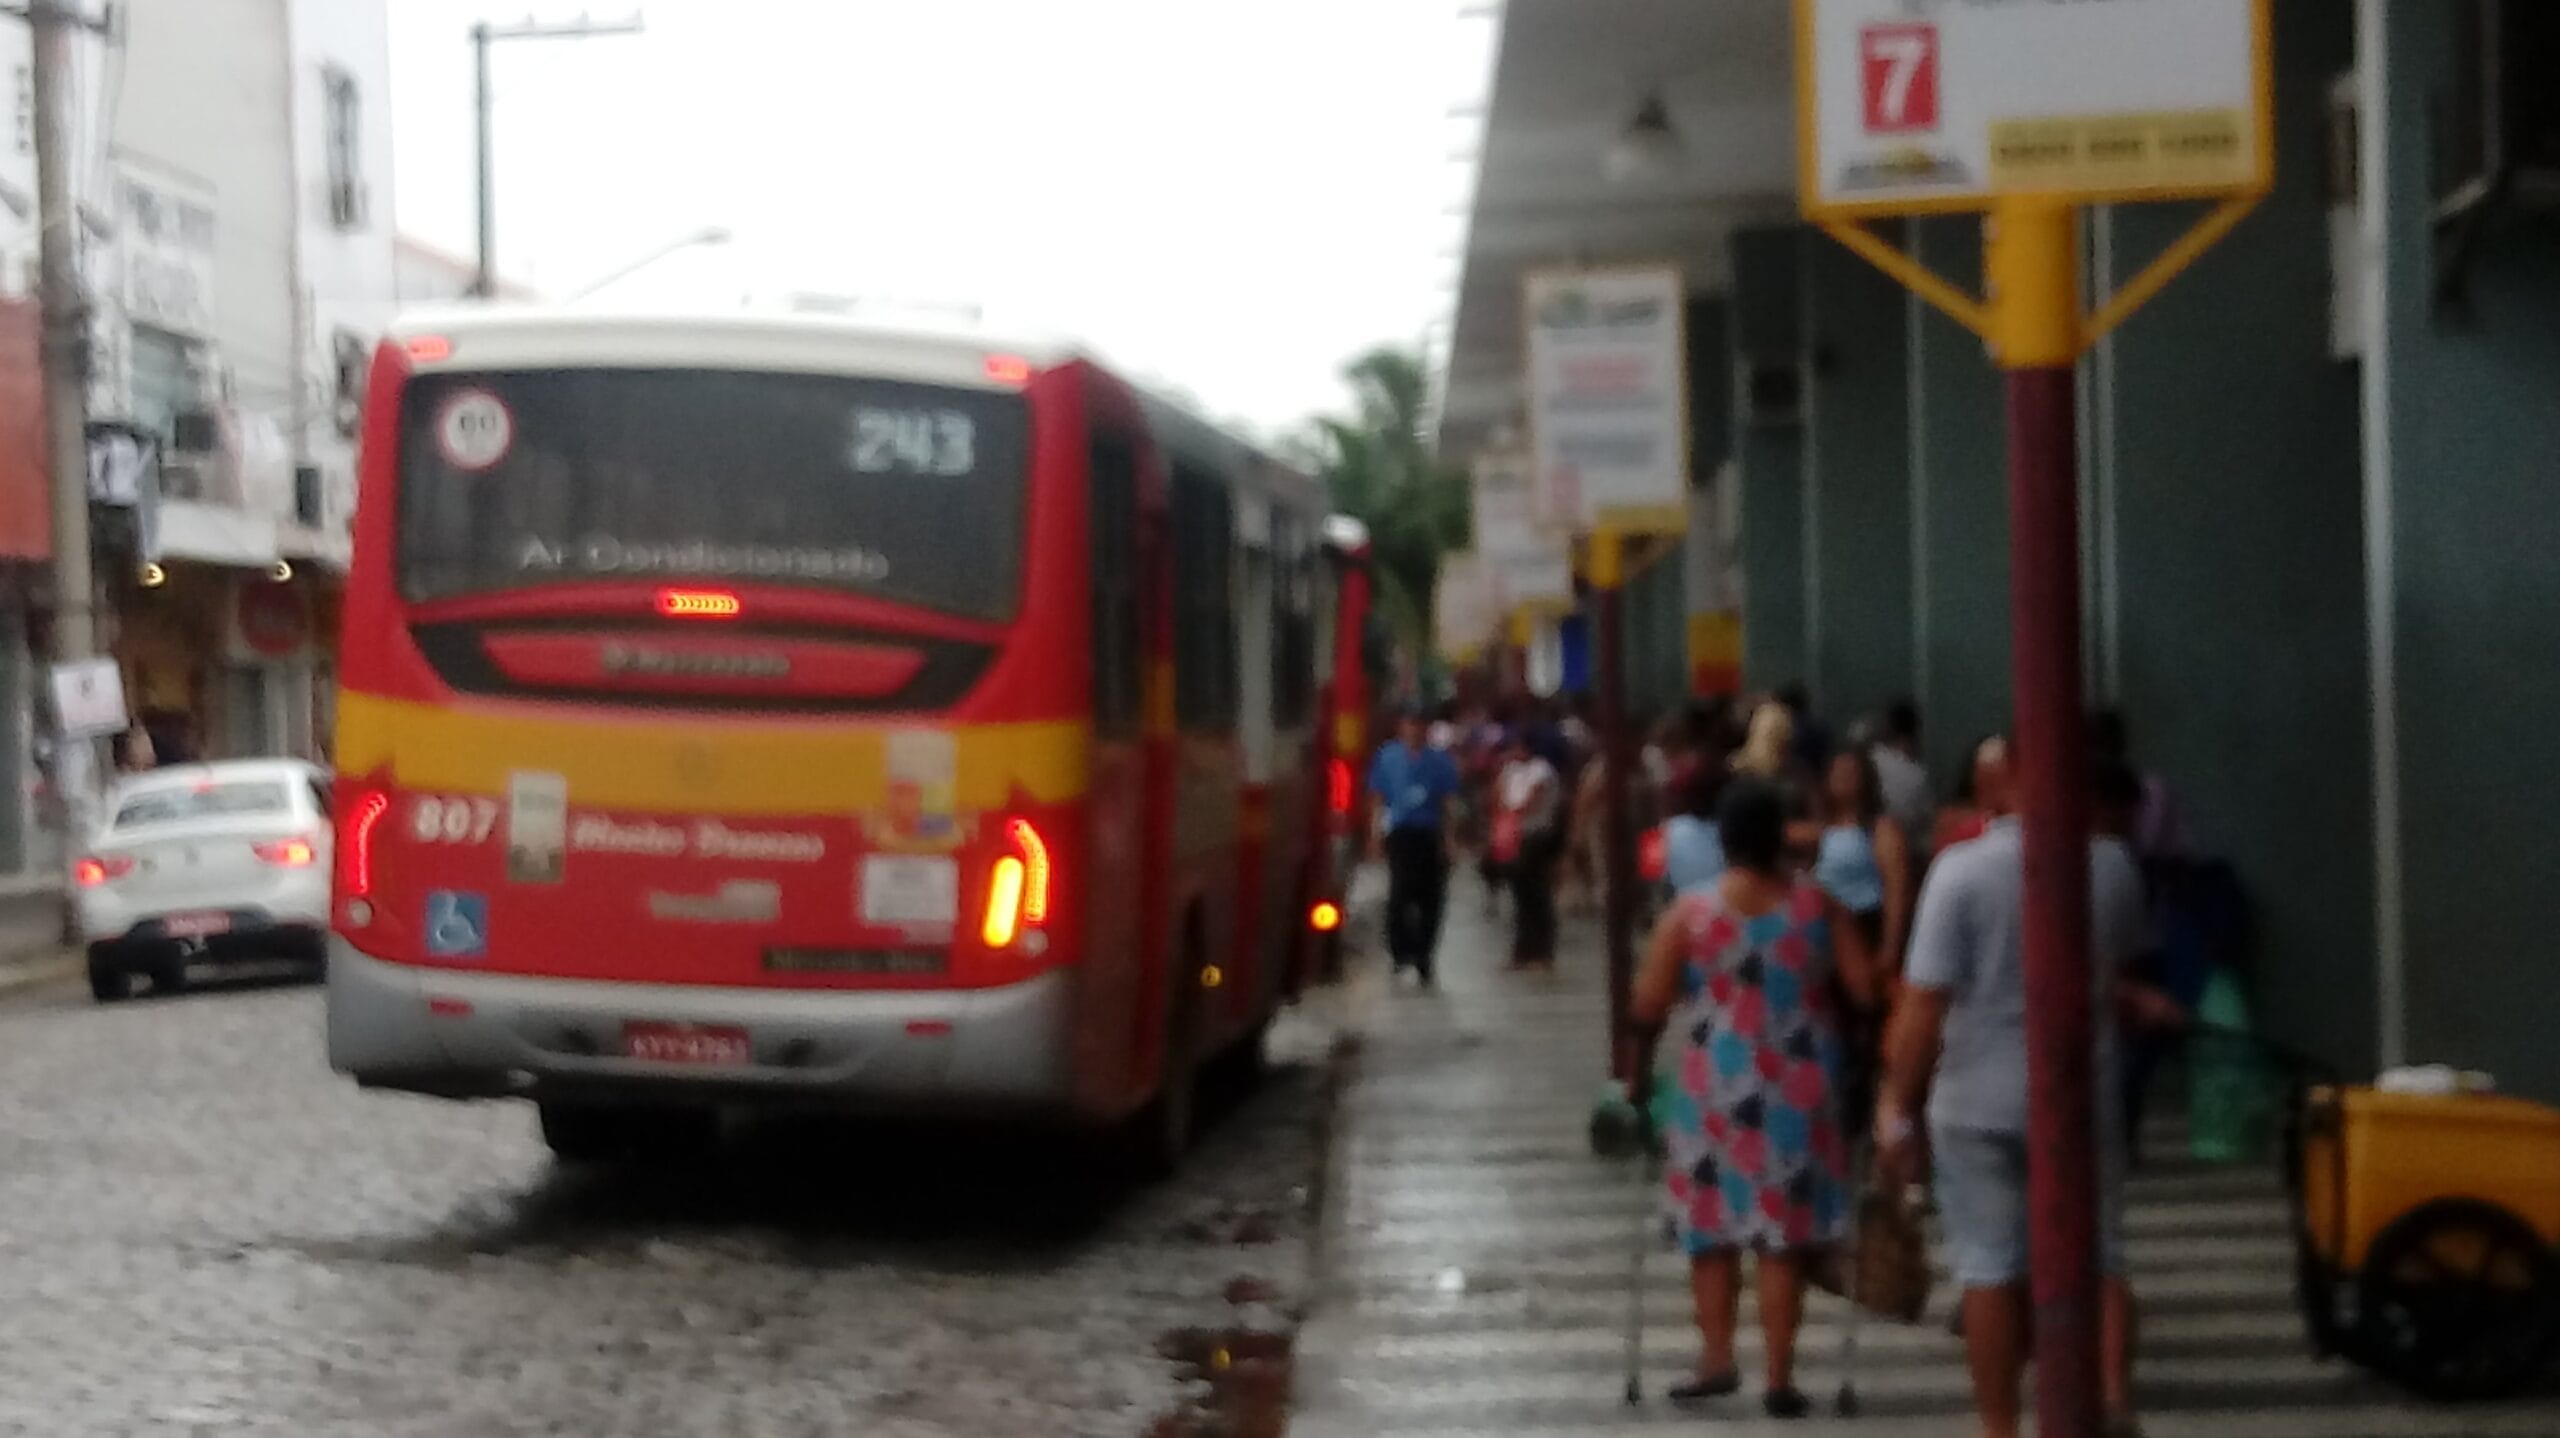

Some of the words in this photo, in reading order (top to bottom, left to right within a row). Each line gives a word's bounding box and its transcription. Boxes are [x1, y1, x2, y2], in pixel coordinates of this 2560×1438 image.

[1872, 37, 1928, 122] 7
[854, 408, 976, 477] 243
[585, 534, 890, 581] Condicionado
[413, 794, 499, 844] 807
